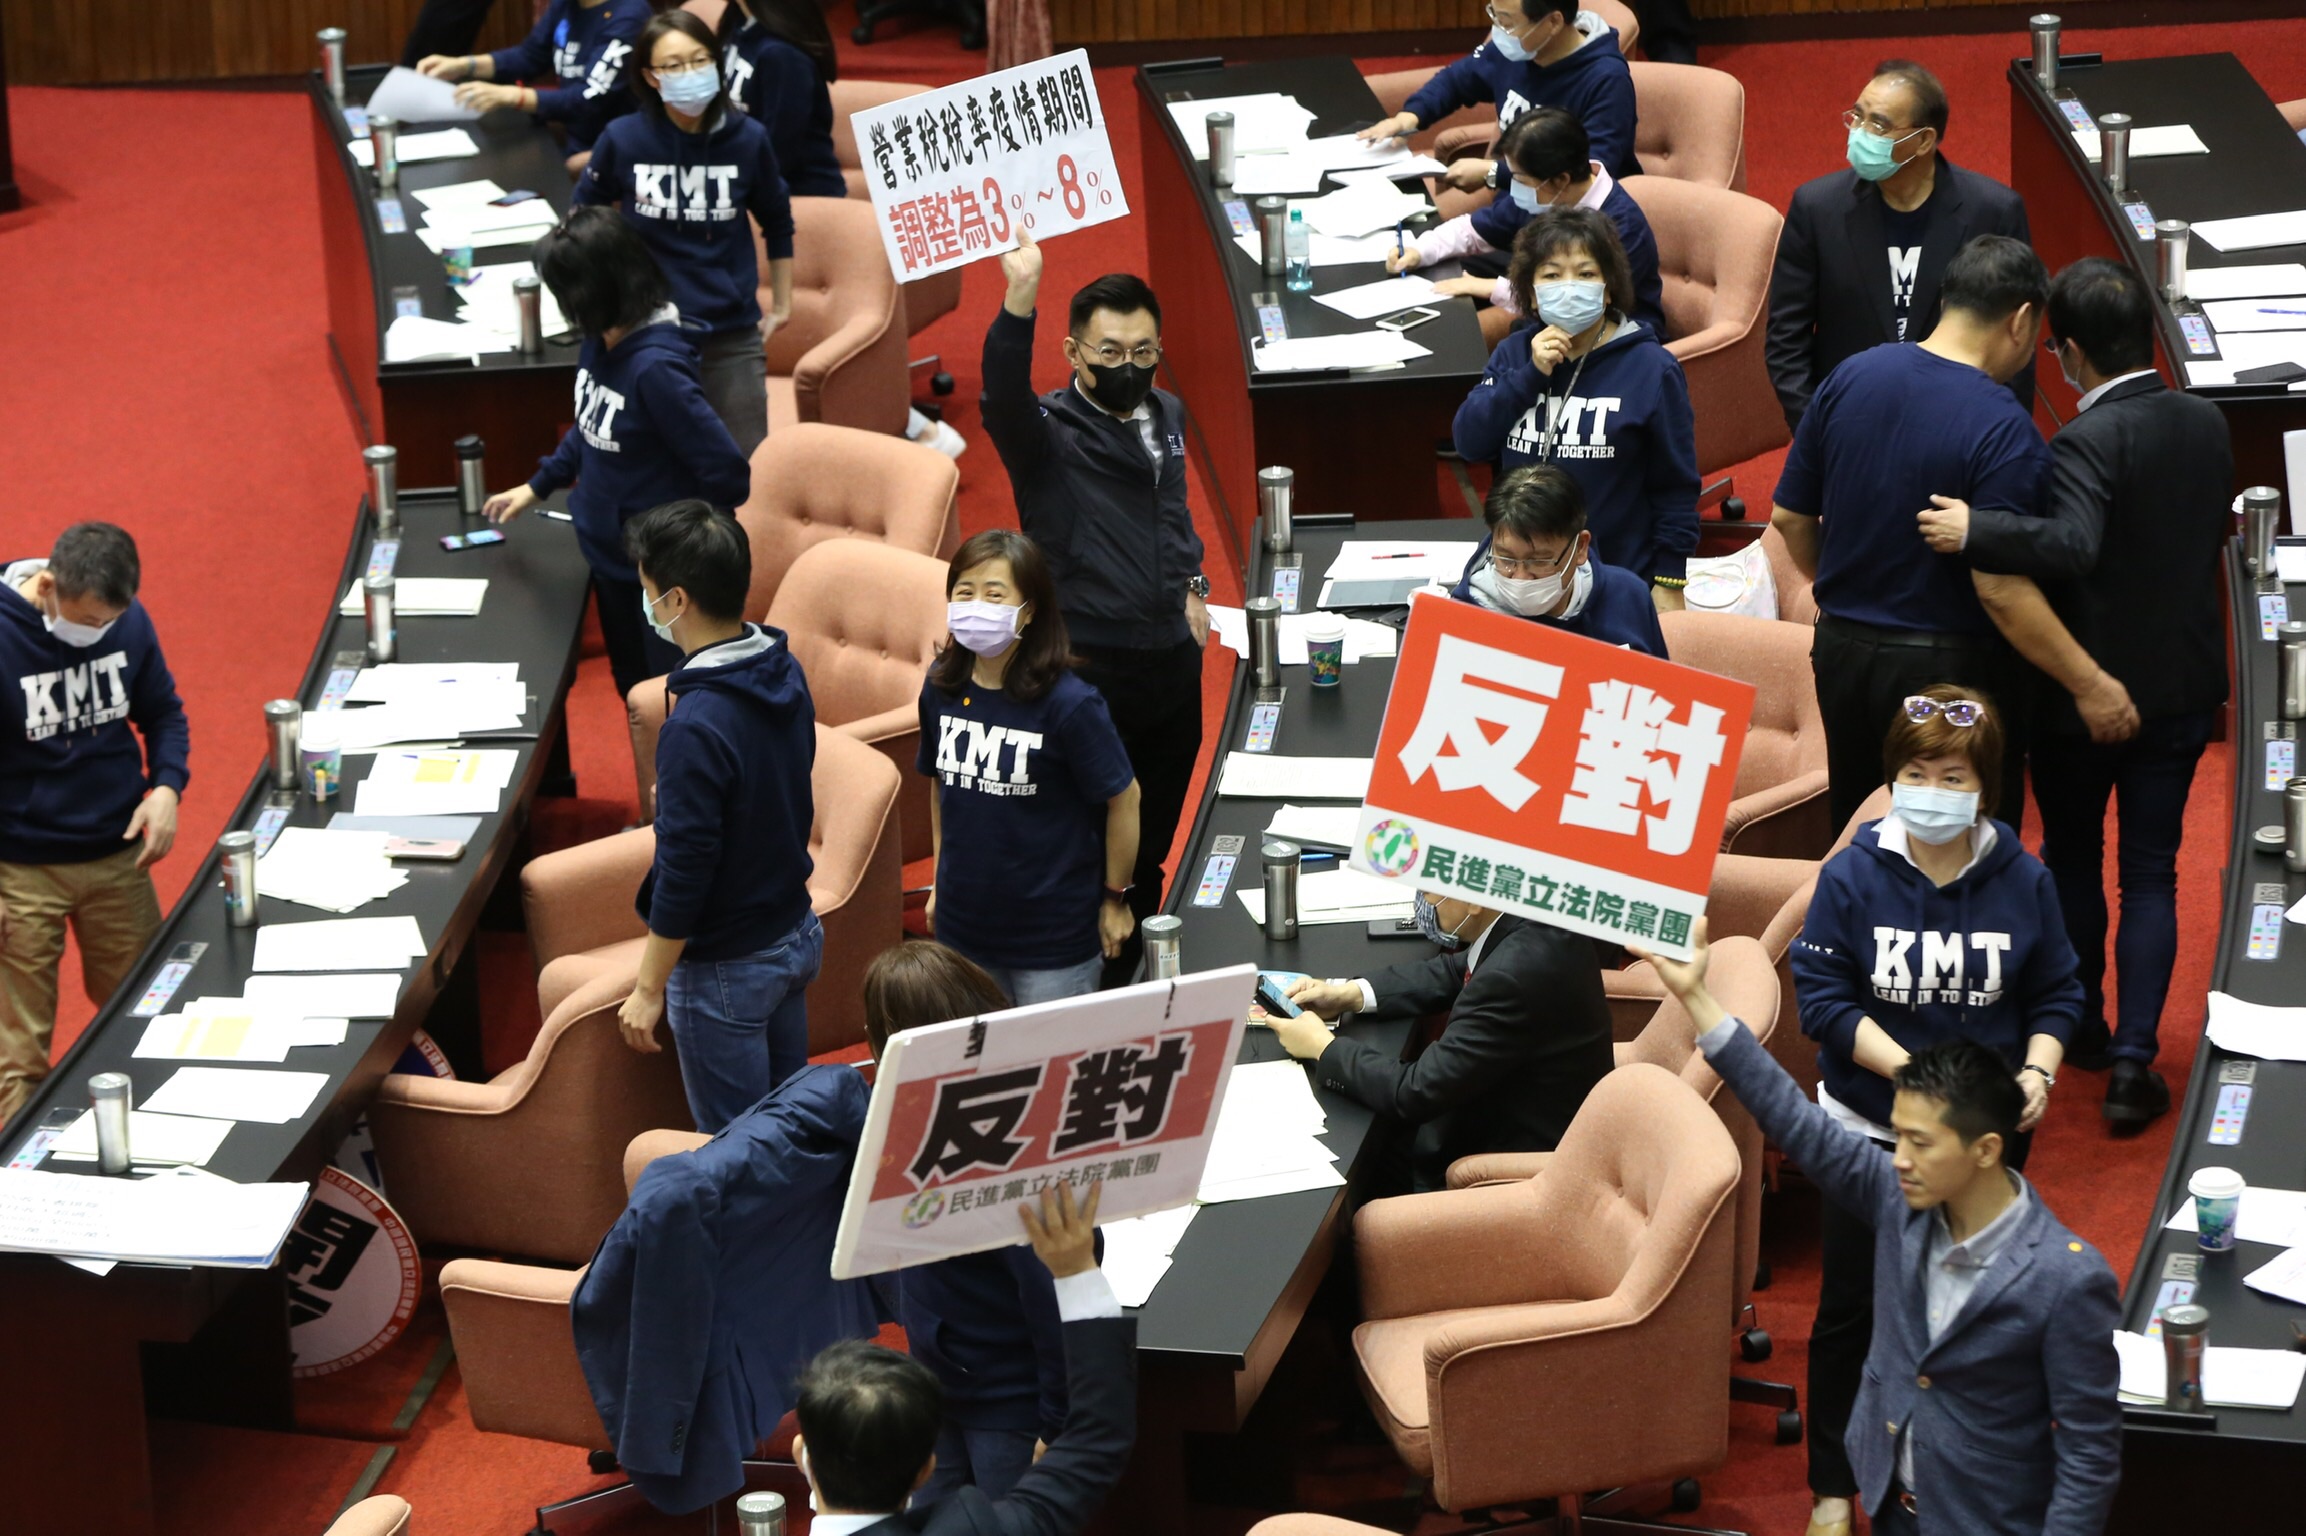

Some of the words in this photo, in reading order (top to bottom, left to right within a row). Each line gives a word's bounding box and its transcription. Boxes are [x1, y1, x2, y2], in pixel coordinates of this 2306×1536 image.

[868, 63, 1094, 190] 營業稅稅率疫情期間
[633, 163, 738, 209] KMT
[1506, 437, 1532, 455] LEAN
[1556, 446, 1615, 459] TOGETHER
[1509, 393, 1622, 446] KMT
[20, 650, 128, 730] KMT
[936, 715, 1043, 784] KMT
[1397, 632, 1728, 857] 反對
[977, 778, 1038, 796] TOGETHER
[1420, 845, 1693, 948] 民進黨立法院黨團
[1870, 926, 2011, 992] KMT
[1873, 985, 1909, 1005] LEAN
[1917, 989, 1933, 1005] IN
[908, 1037, 1188, 1186] 反對
[948, 1152, 1162, 1215] 民進黨立法院黨團
